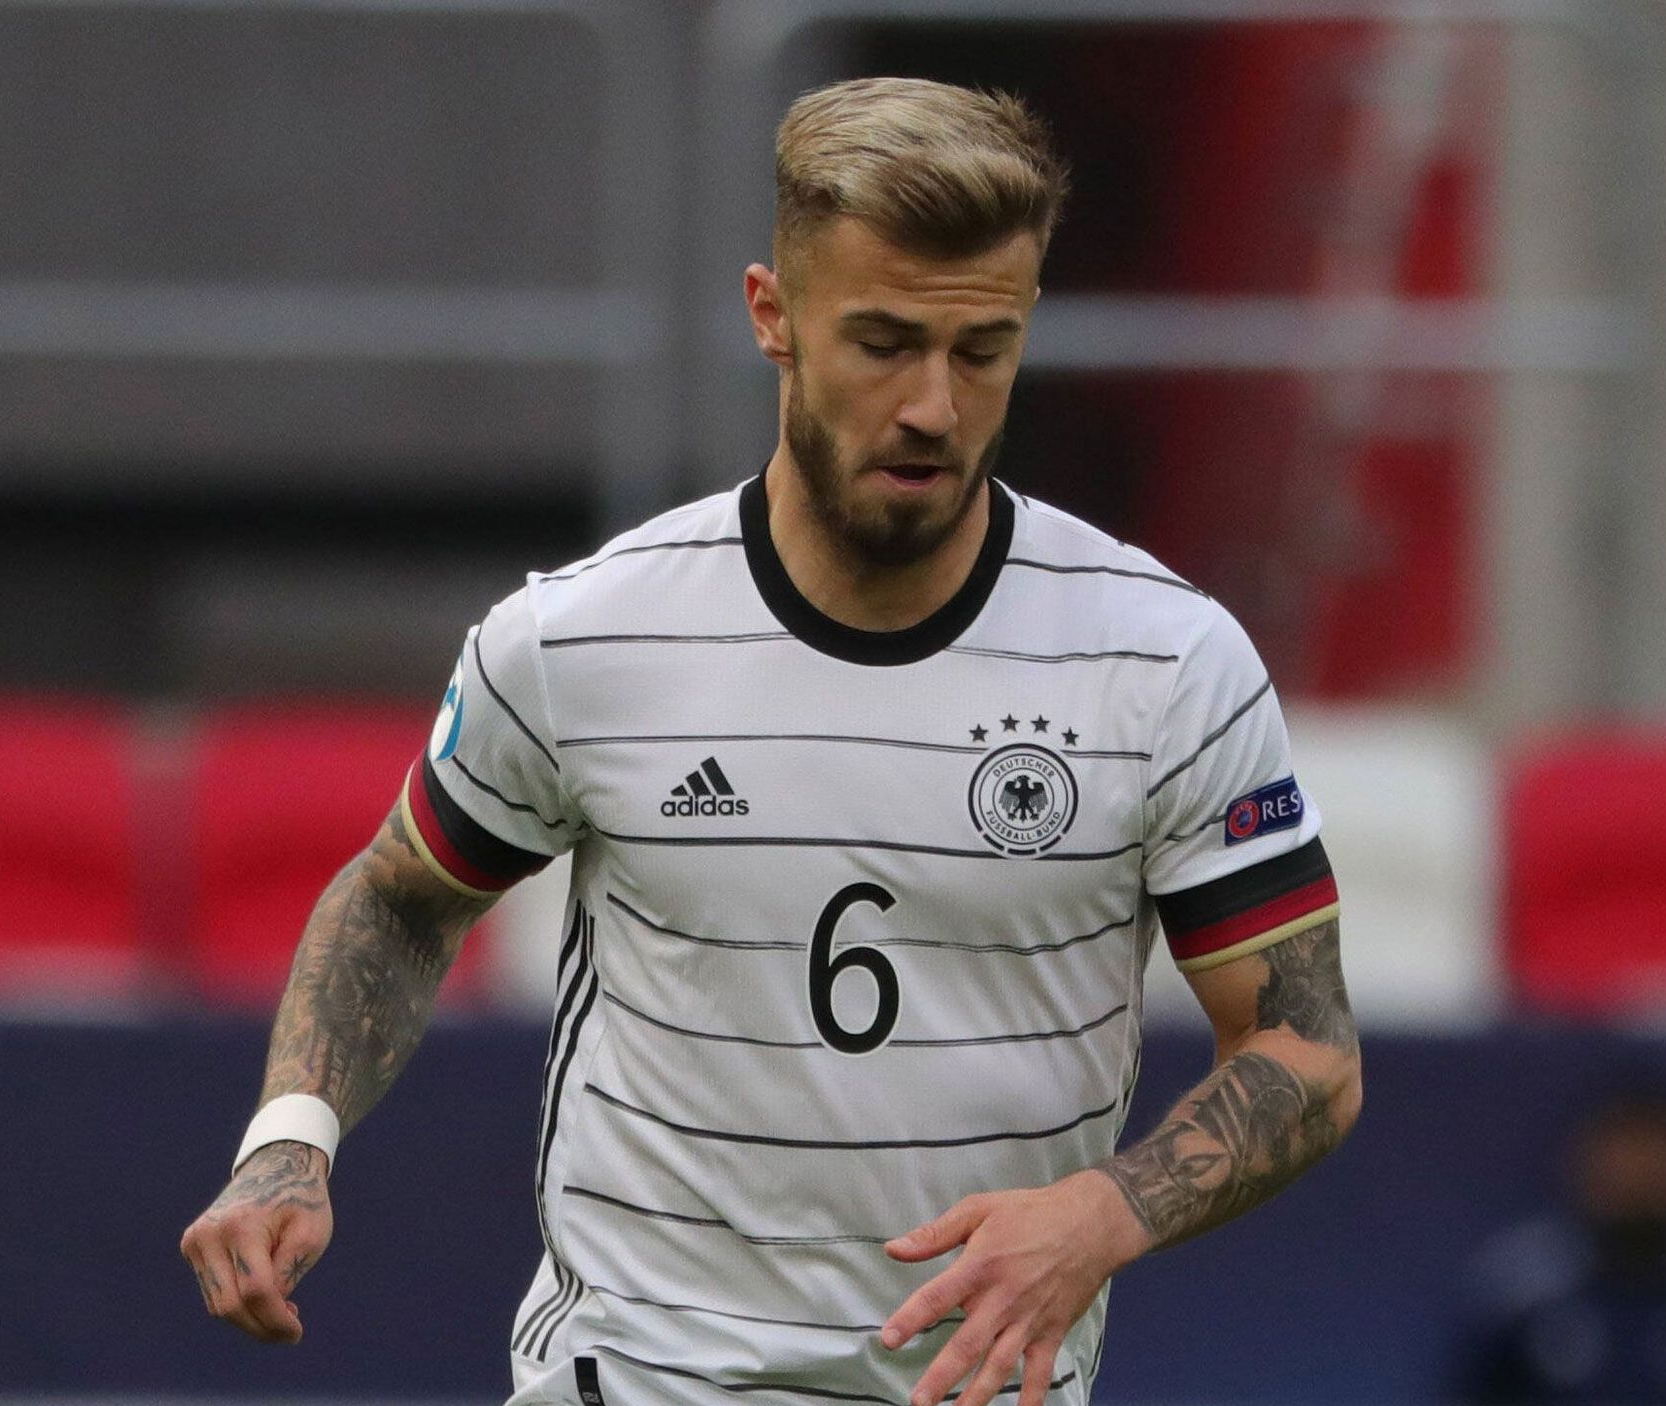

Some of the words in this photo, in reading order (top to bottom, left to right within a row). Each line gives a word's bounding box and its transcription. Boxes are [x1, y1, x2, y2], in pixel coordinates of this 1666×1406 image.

[992, 757, 1056, 779] DEUTSCHER
[660, 794, 750, 817] adidas
[809, 881, 900, 1055] 6
